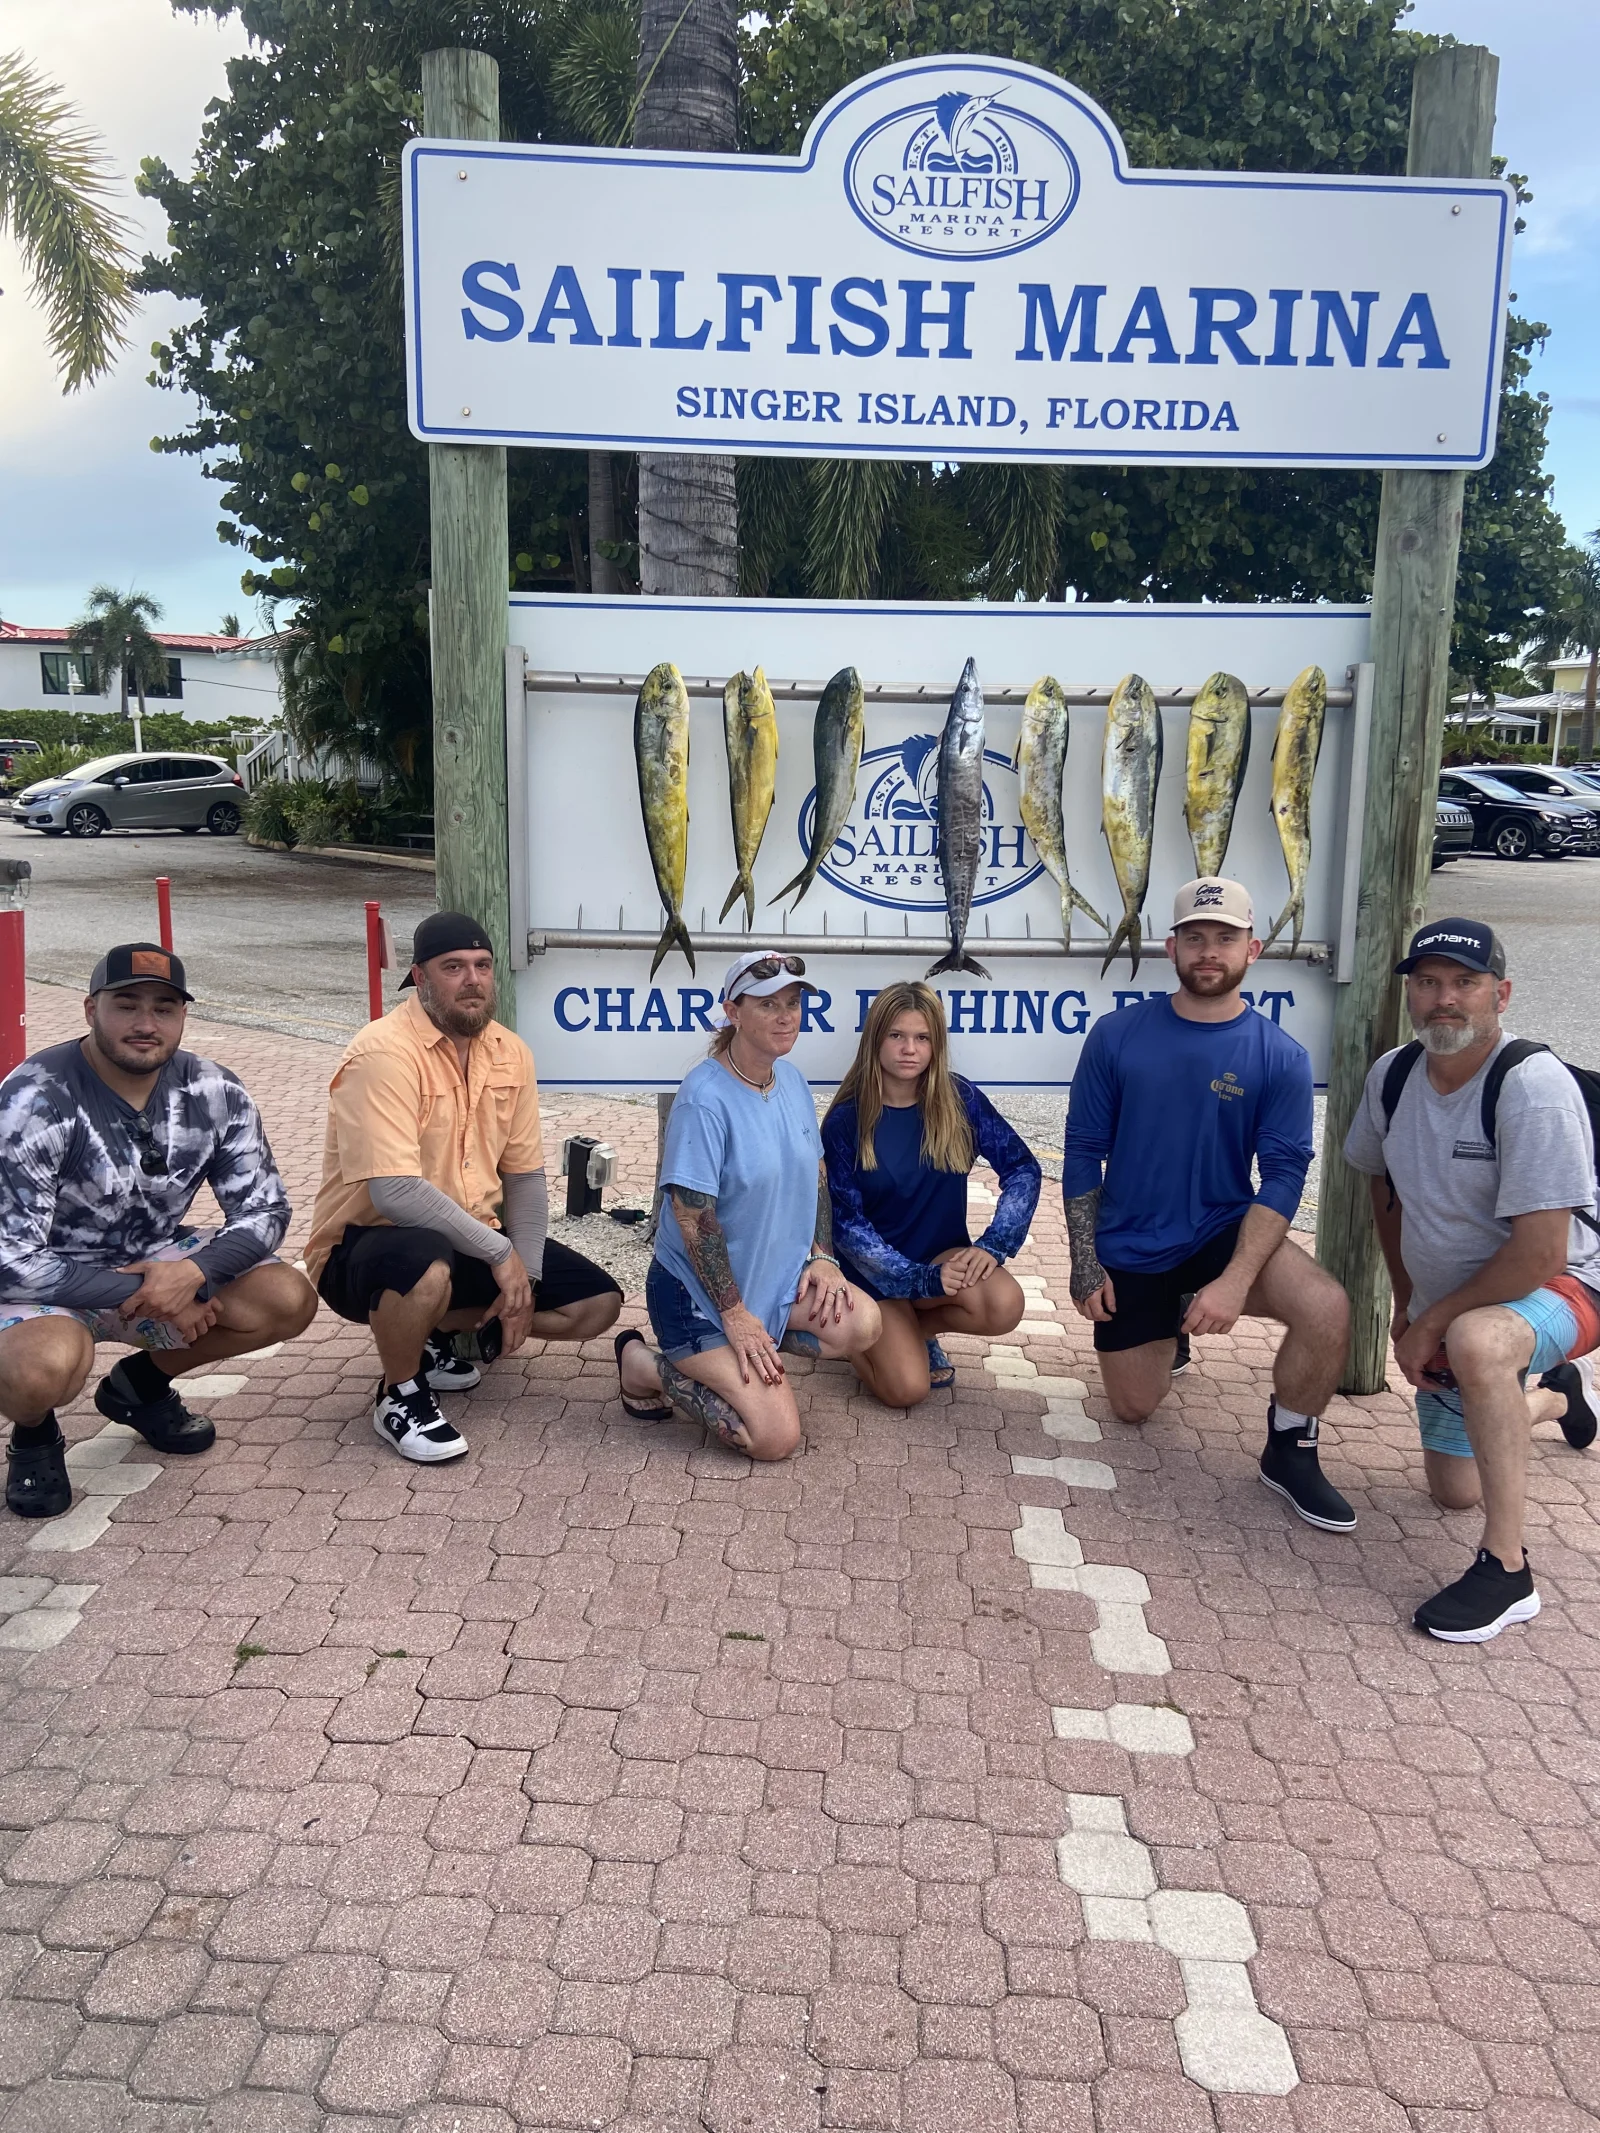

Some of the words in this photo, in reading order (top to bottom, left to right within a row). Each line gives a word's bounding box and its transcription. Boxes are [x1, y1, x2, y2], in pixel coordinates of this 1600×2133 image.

[995, 136, 1012, 172] 1952
[872, 174, 1049, 220] SAILFISH
[899, 225, 1022, 237] RESORT
[910, 213, 1004, 225] MARINA
[461, 260, 975, 359] SAILFISH
[1015, 283, 1450, 369] MARINA
[676, 385, 842, 423] SINGER
[857, 392, 1029, 435] ISLAND,
[1046, 397, 1240, 432] FLORIDA
[859, 875, 998, 886] RESOT
[1417, 933, 1480, 948] carhartt
[553, 986, 835, 1033] CHARR
[1211, 1079, 1244, 1097] Corona
